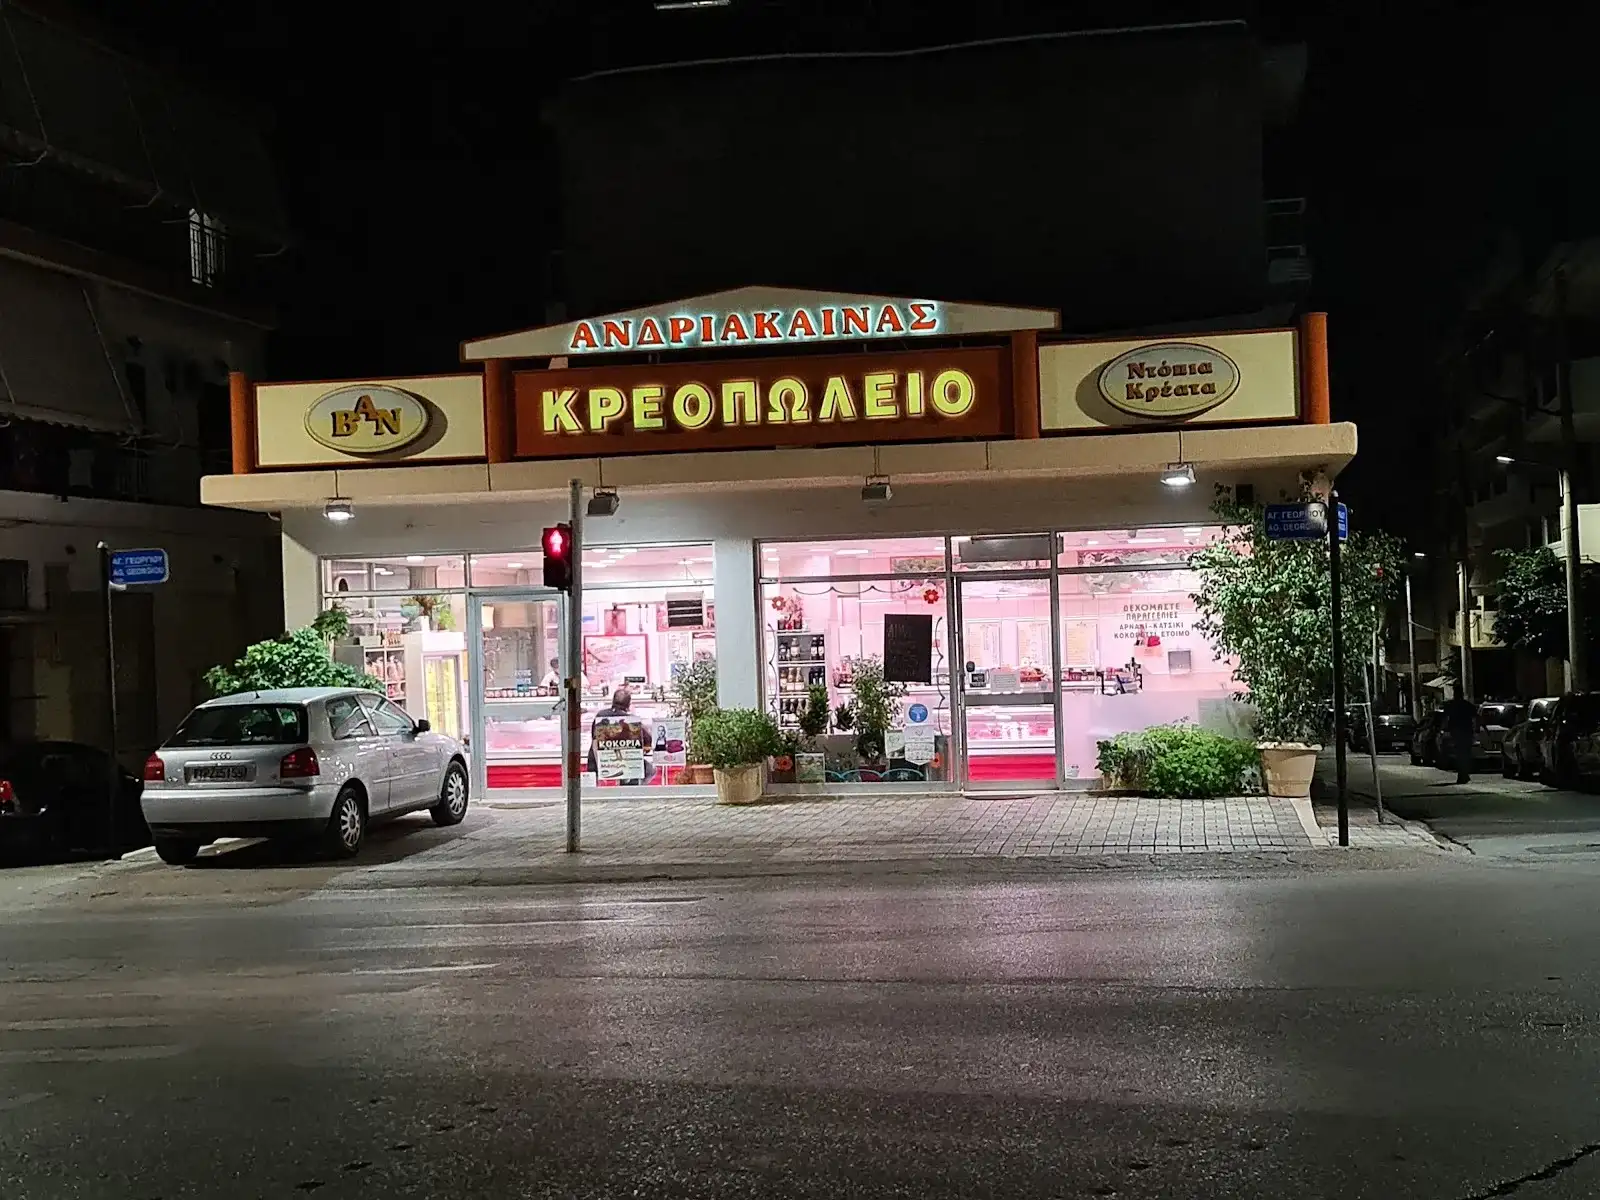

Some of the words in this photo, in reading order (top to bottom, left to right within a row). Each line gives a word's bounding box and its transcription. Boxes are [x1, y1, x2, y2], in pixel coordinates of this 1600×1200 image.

[570, 303, 937, 349] ΑΝΔΡΙΑΚΑΙΝΑΣ
[1127, 360, 1213, 379] Ντόπια
[542, 370, 974, 433] ΚΡΕΟΠΩΛΕΙΟ
[1126, 381, 1217, 402] Κρέατα
[1123, 602, 1180, 612] ΔΕΧΟΜΑΣΤΕ
[598, 740, 641, 749] ΚΟΚΟΡΙΑ
